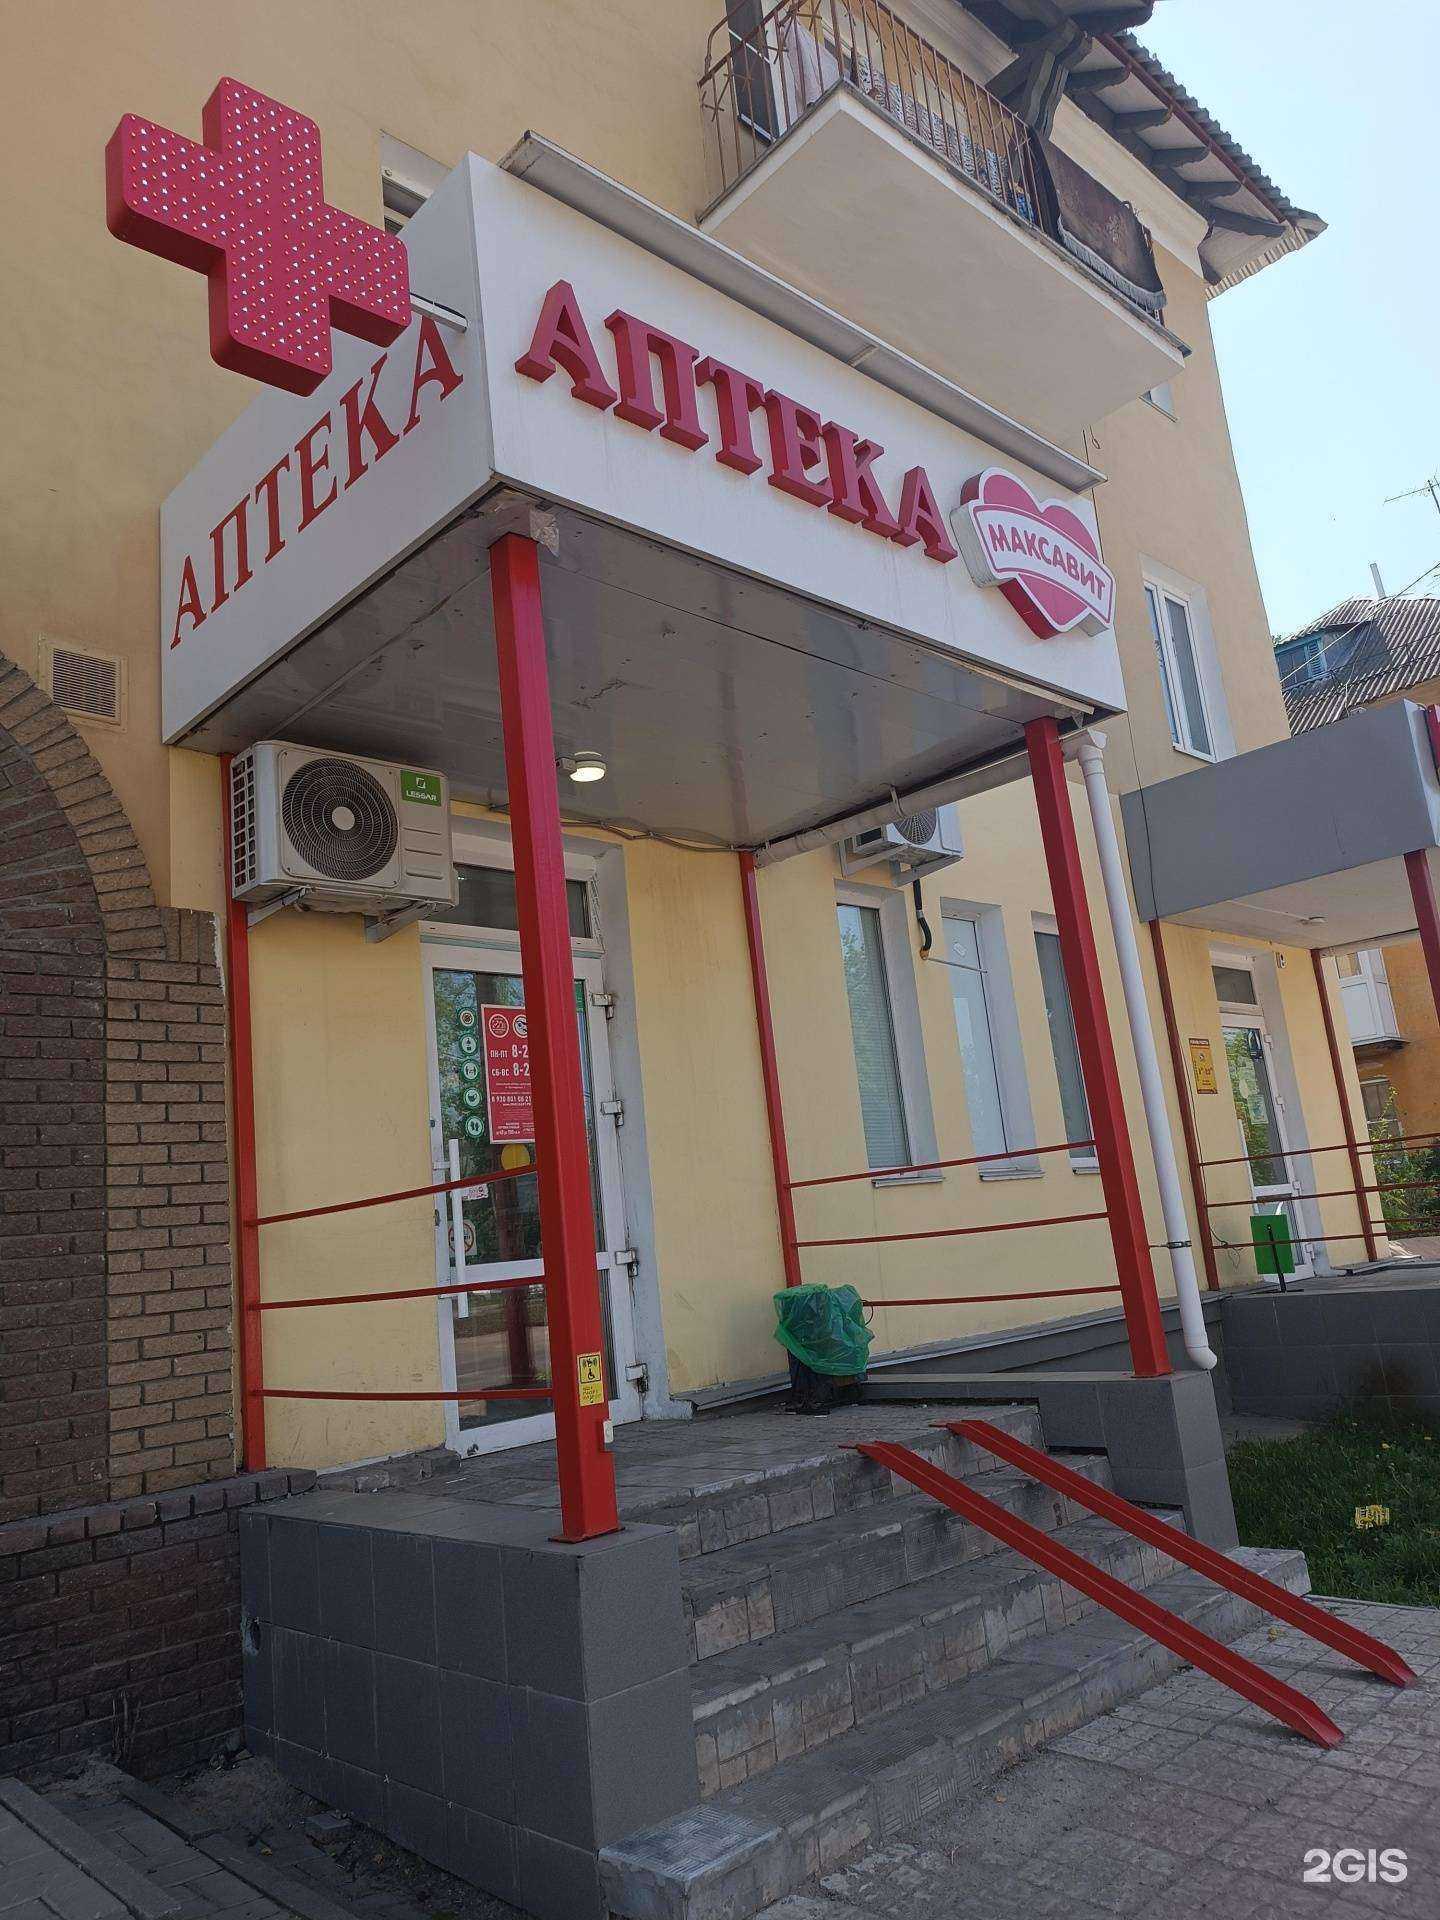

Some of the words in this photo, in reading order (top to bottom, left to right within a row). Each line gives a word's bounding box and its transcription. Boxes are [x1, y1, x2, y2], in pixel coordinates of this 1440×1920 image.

[515, 280, 958, 564] АПТЕКА
[170, 314, 464, 650] АПТЕКА
[988, 523, 1106, 601] МАКСАВИТ
[406, 789, 438, 802] LESSAR
[490, 1049, 509, 1059] ПН-ПТ
[511, 1044, 529, 1059] 8-2
[491, 1068, 510, 1077] СБ-ВС
[513, 1062, 531, 1077] 8-2
